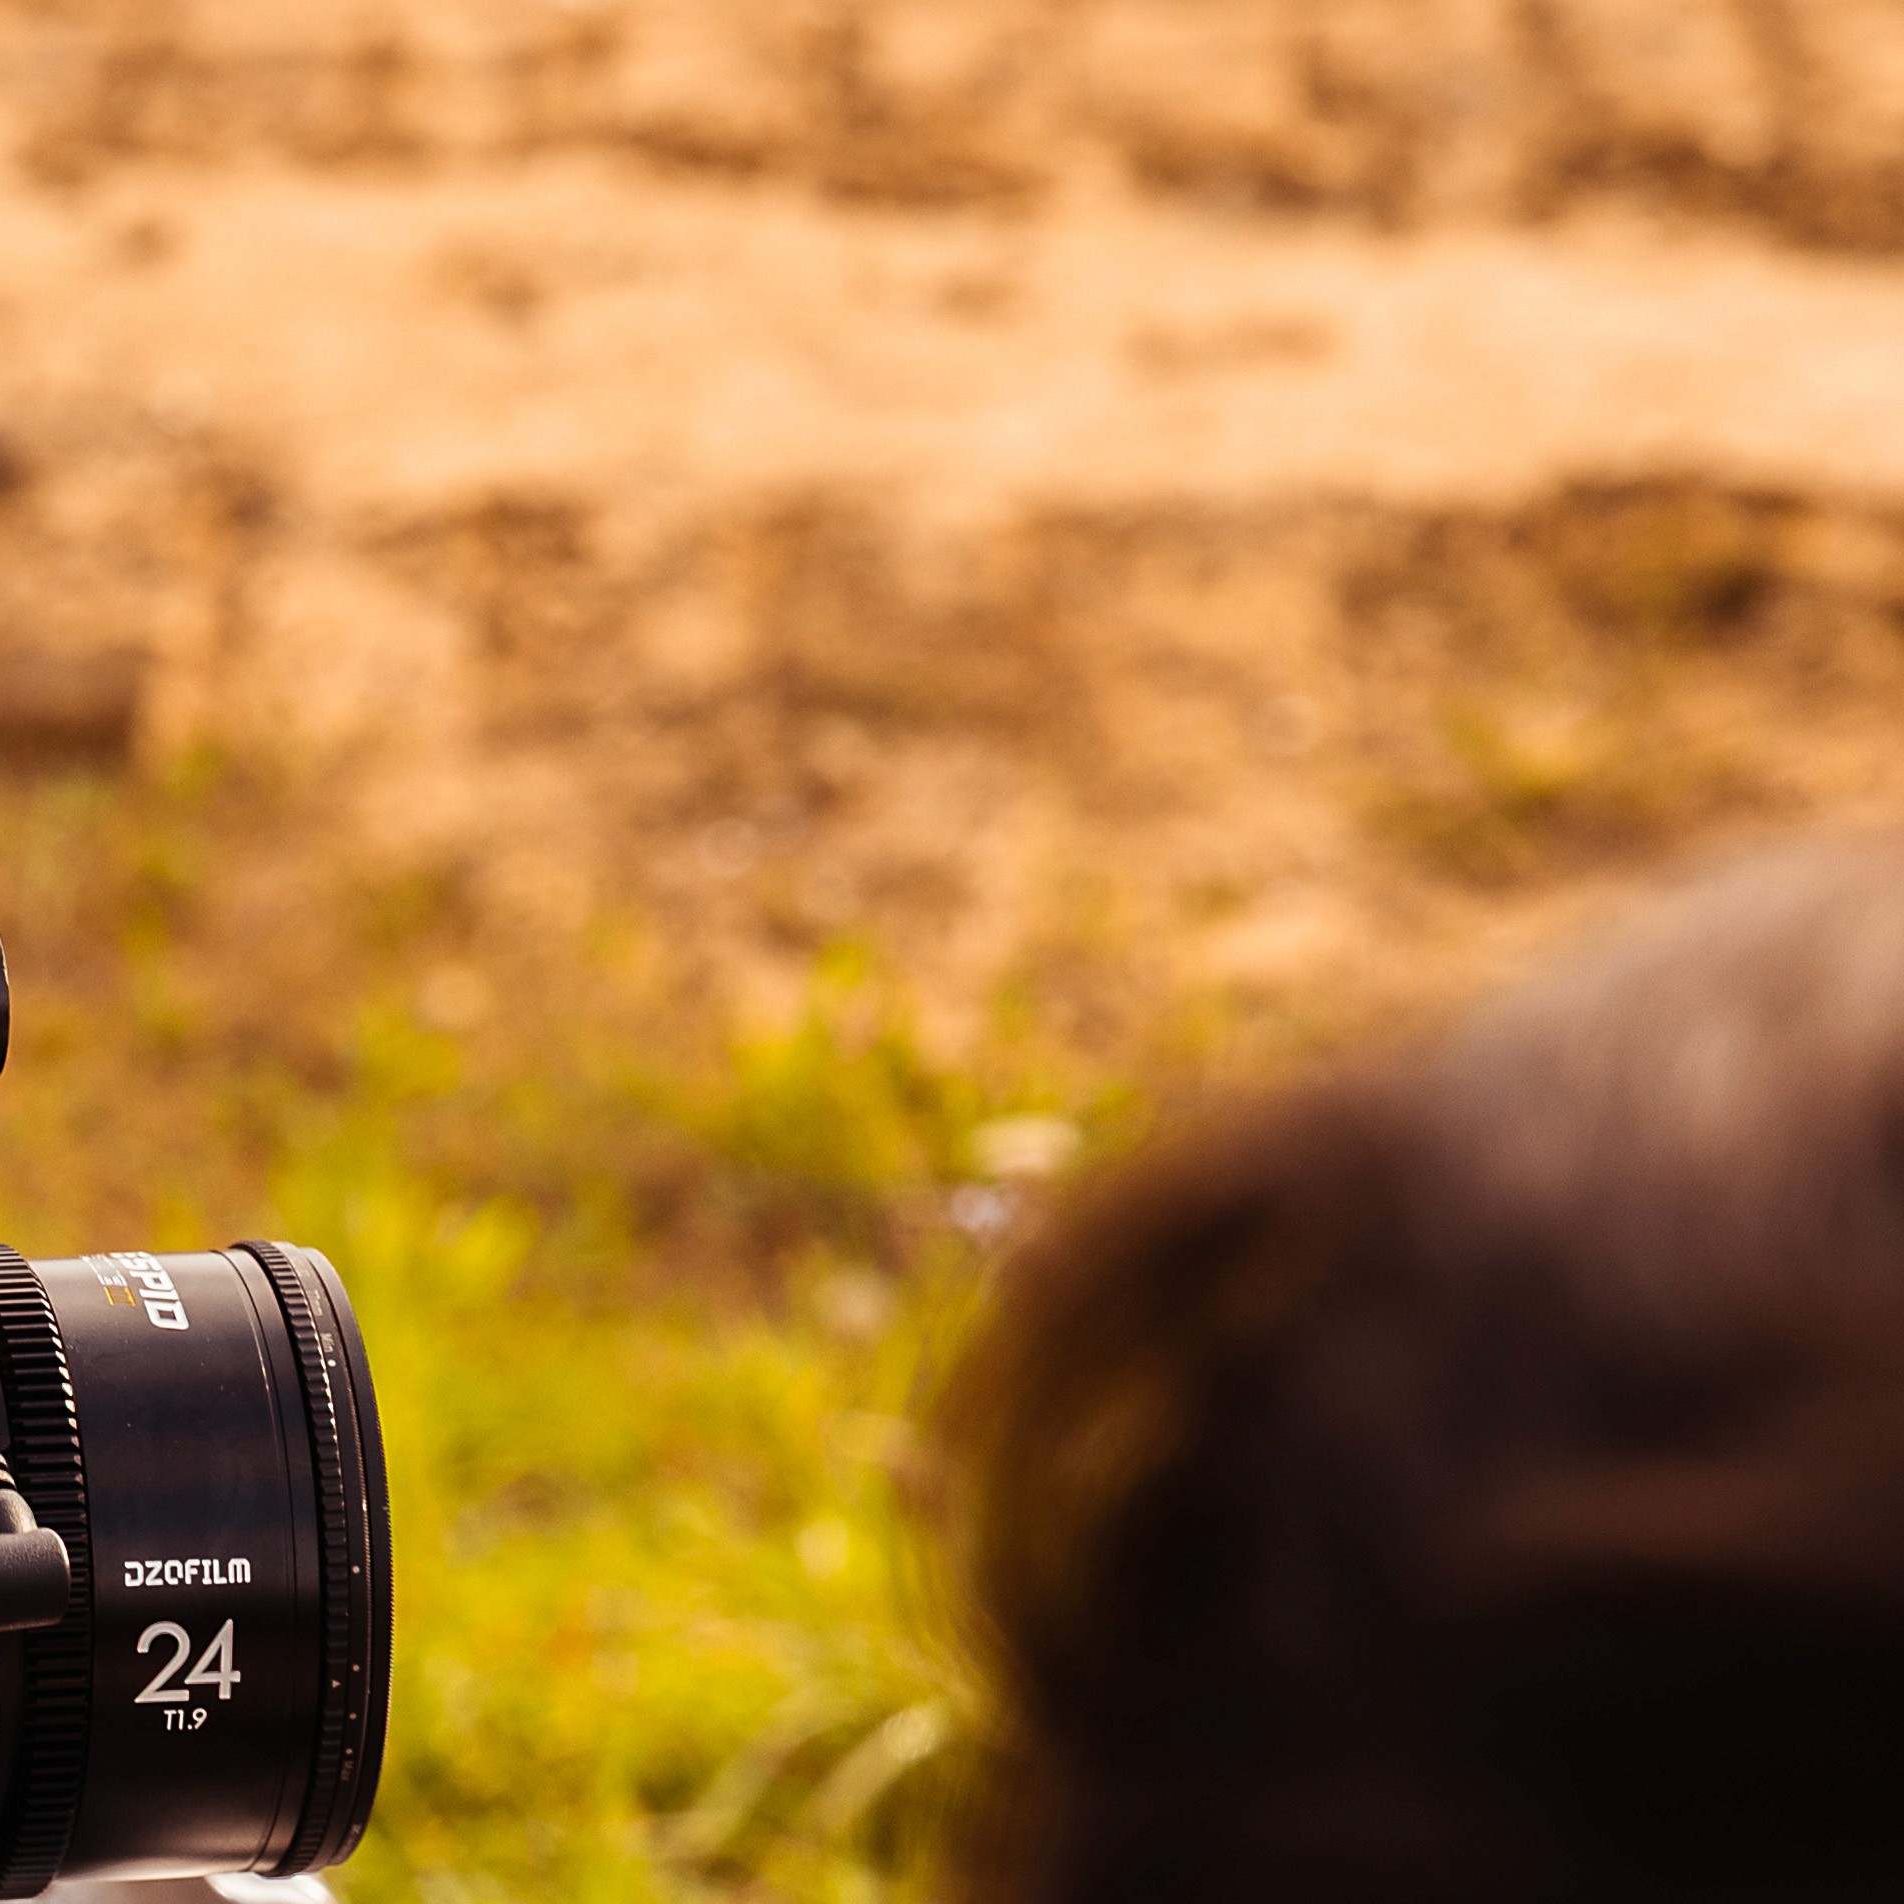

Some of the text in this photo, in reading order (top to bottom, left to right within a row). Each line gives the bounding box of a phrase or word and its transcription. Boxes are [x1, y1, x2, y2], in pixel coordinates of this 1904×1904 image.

[123, 1558, 251, 1587] DZOFILM
[134, 1618, 241, 1704] 24
[162, 1708, 208, 1732] T1.9
